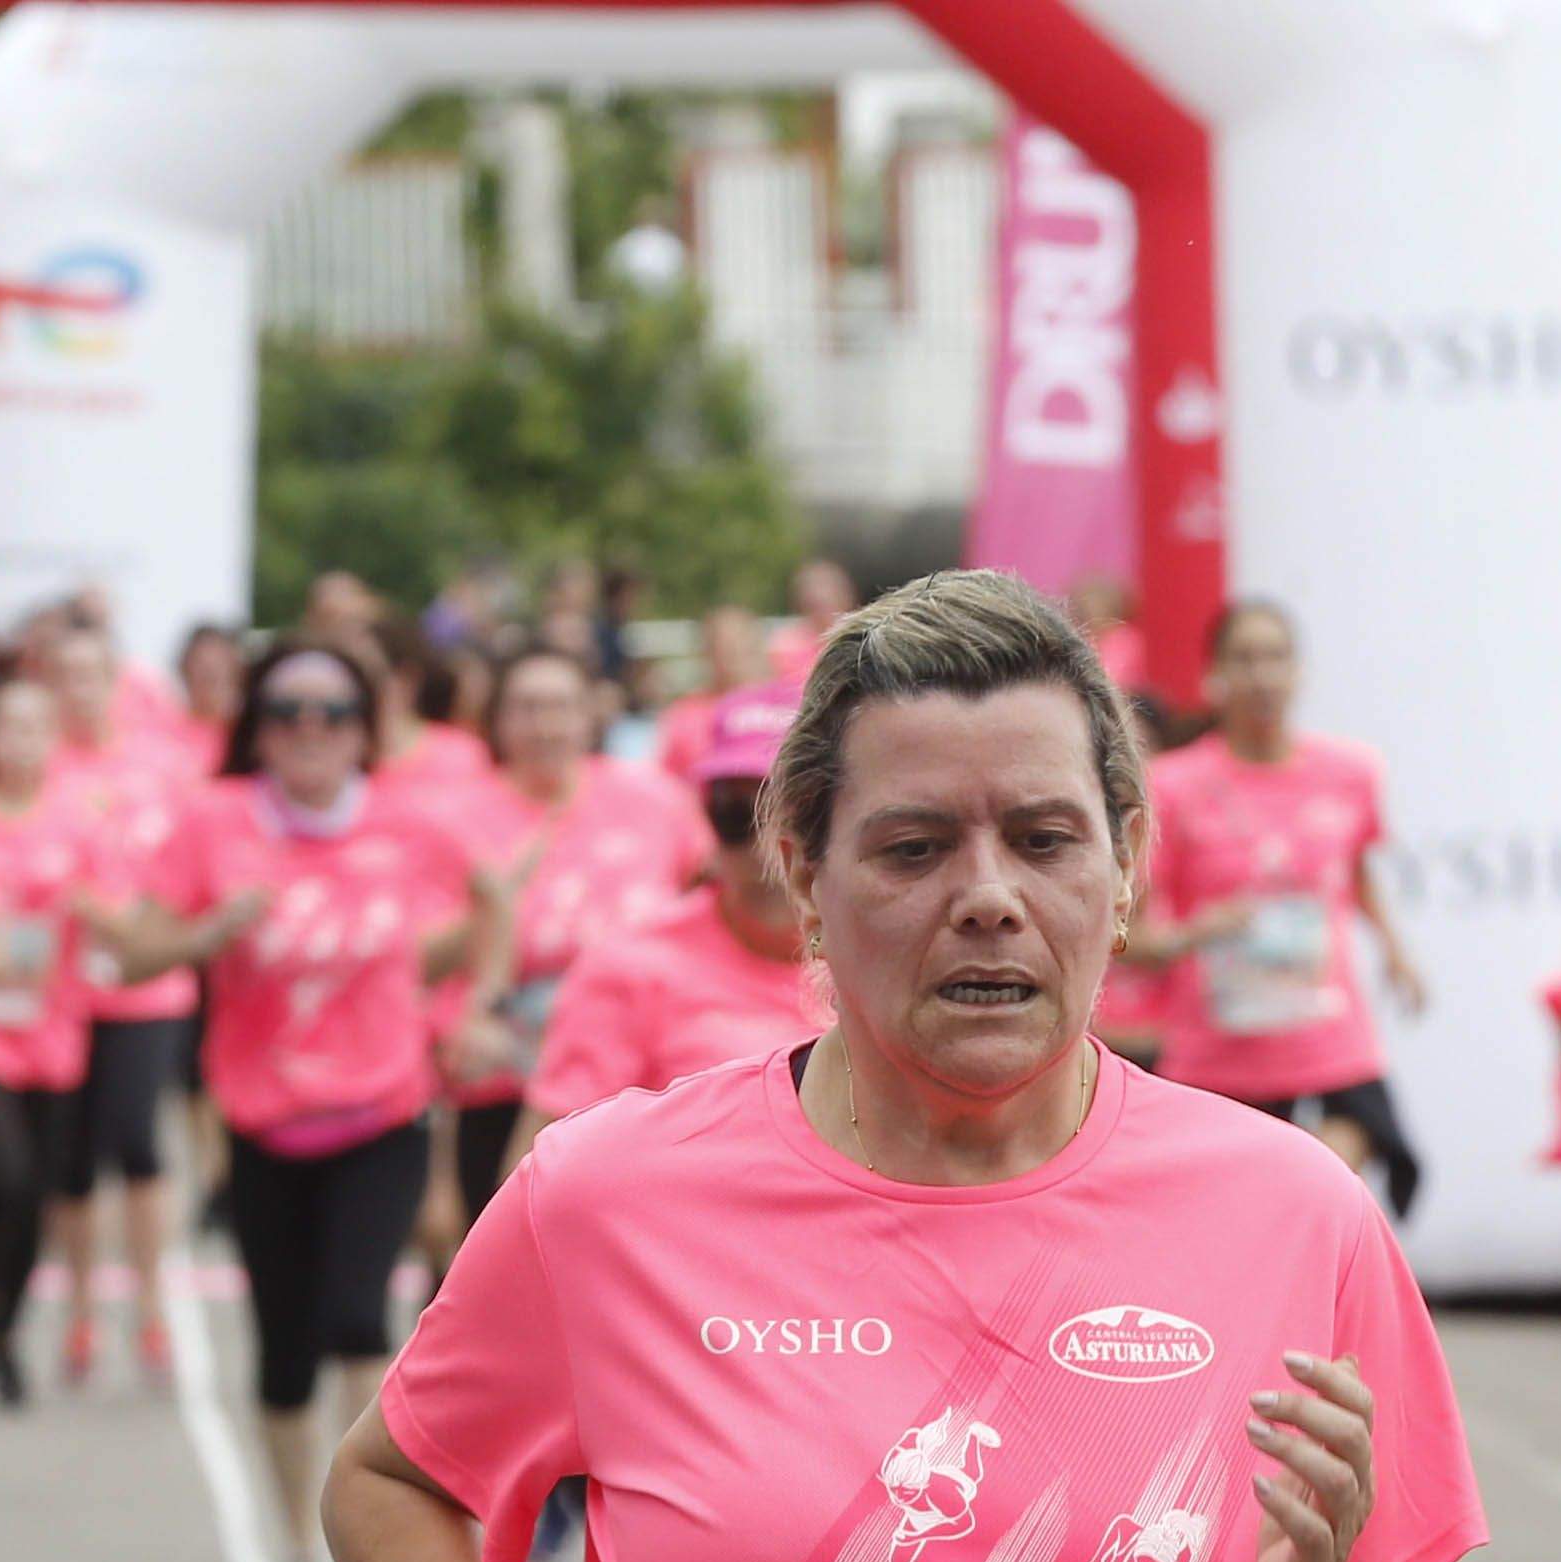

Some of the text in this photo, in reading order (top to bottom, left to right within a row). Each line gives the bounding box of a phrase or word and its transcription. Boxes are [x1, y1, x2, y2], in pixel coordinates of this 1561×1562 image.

[701, 1316, 892, 1355] OYSHO
[1063, 1331, 1202, 1362] ASTURIANA
[1088, 1330, 1138, 1339] CENTRAL
